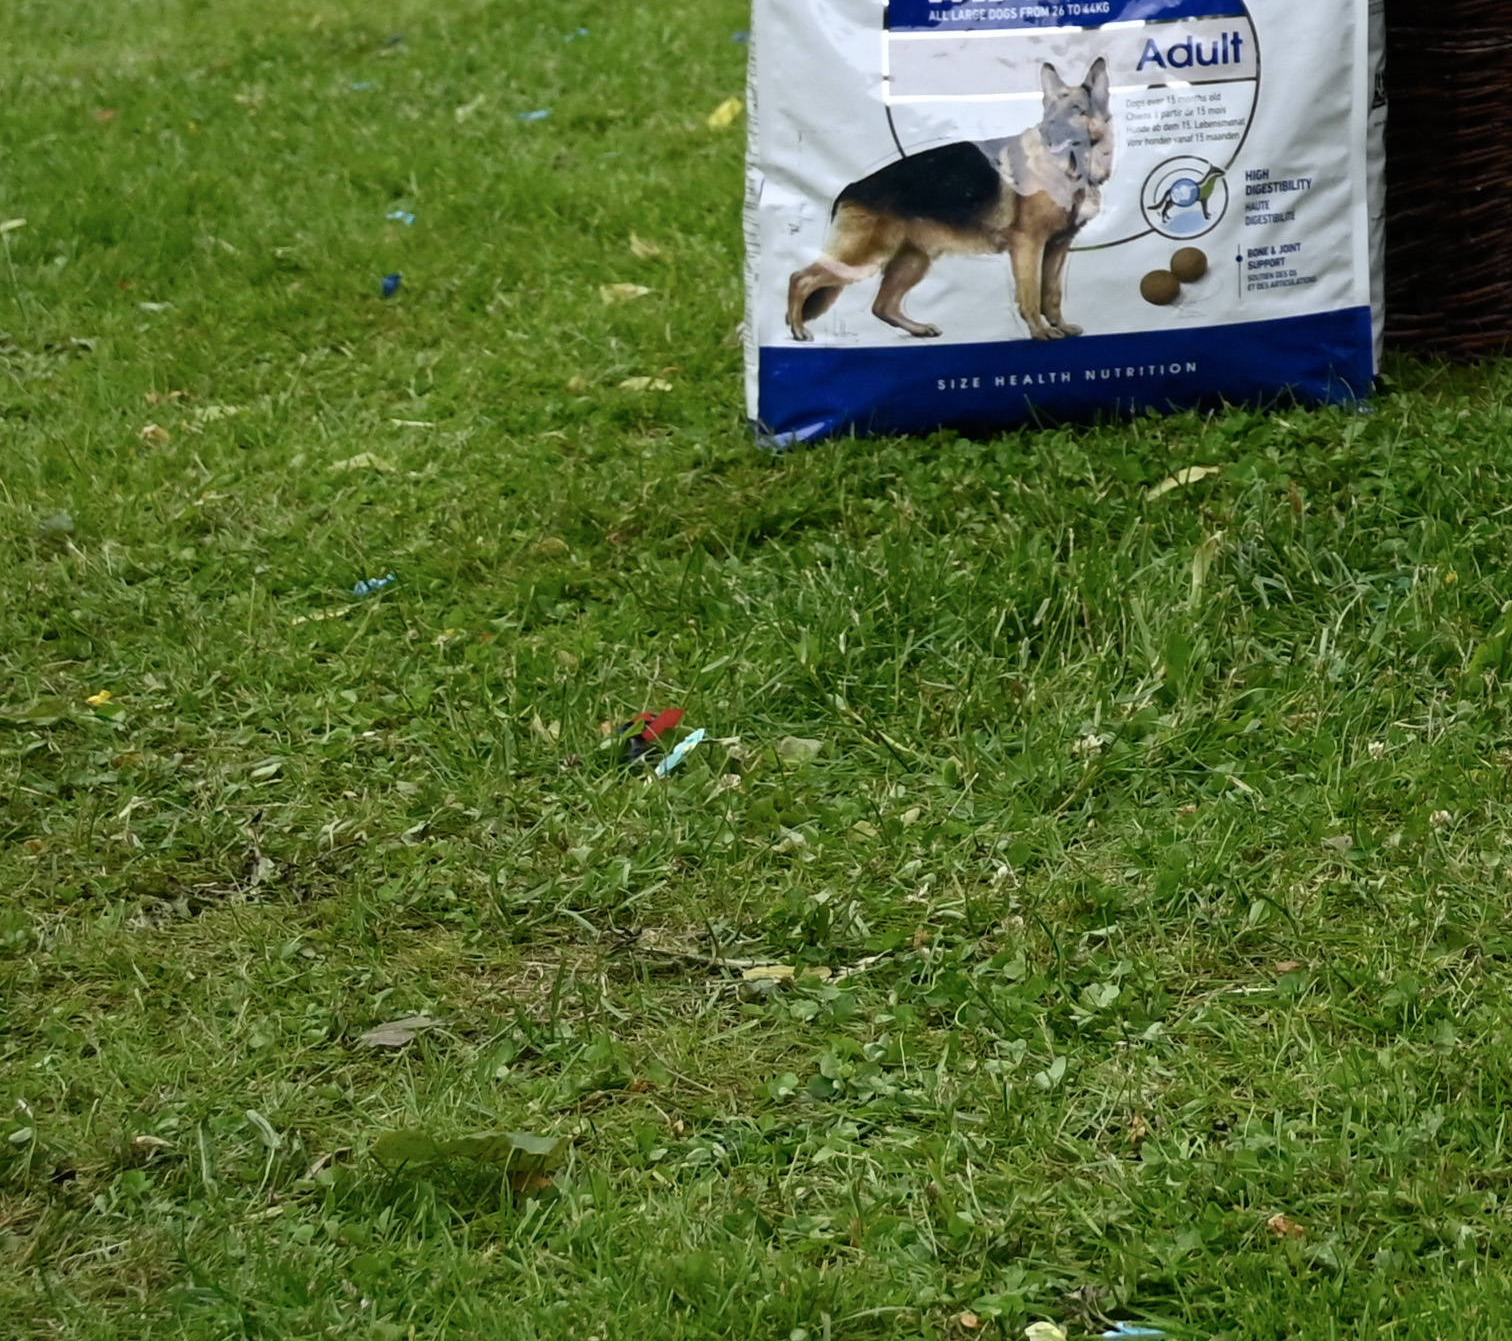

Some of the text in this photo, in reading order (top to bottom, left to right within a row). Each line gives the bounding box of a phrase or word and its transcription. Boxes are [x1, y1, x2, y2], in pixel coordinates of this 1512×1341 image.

[929, 2, 1110, 22] ALL LARGE DOGS FROM 26 TO 44KG
[1136, 30, 1243, 71] Adult
[1245, 169, 1270, 181] HIGH
[1245, 178, 1312, 196] DIGESTIBILITY
[1247, 257, 1286, 270] SUPPORT
[937, 362, 1197, 390] SIZE HEALTH NUTRITION
